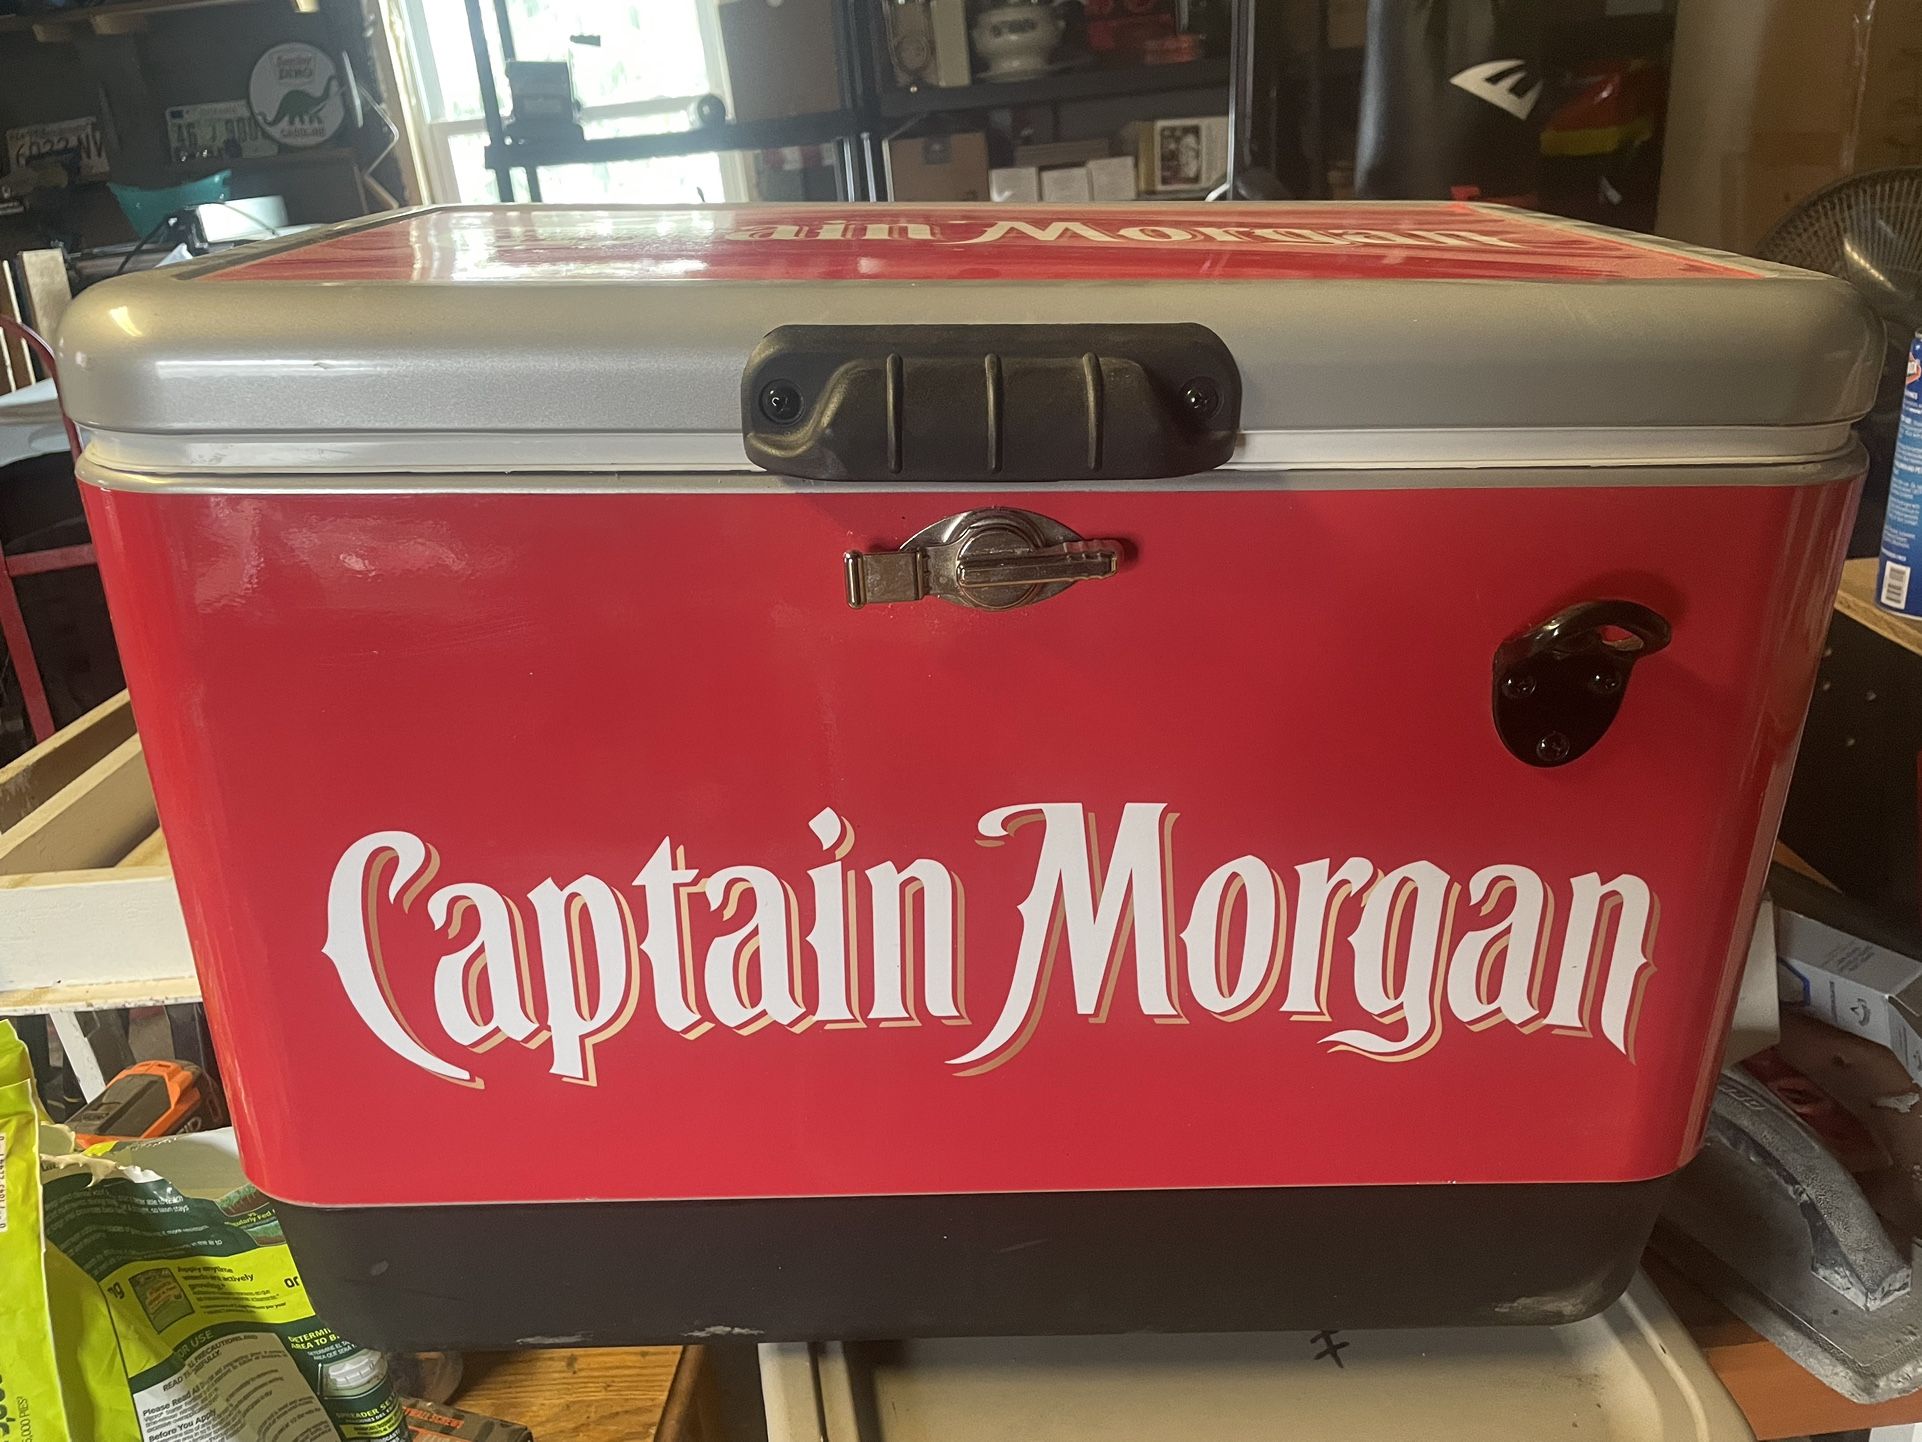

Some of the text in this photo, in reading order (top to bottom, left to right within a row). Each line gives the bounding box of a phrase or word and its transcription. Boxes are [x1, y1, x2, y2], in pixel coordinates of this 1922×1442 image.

[934, 219, 1527, 248] Morgan
[321, 801, 1658, 1089] Captain Morgan
[314, 1336, 328, 1346] TO
[163, 1376, 184, 1393] READ
[143, 1402, 171, 1417] Please
[171, 1390, 192, 1407] Read
[149, 1426, 177, 1442] Before
[177, 1420, 194, 1432] You
[195, 1408, 217, 1425] Apply
